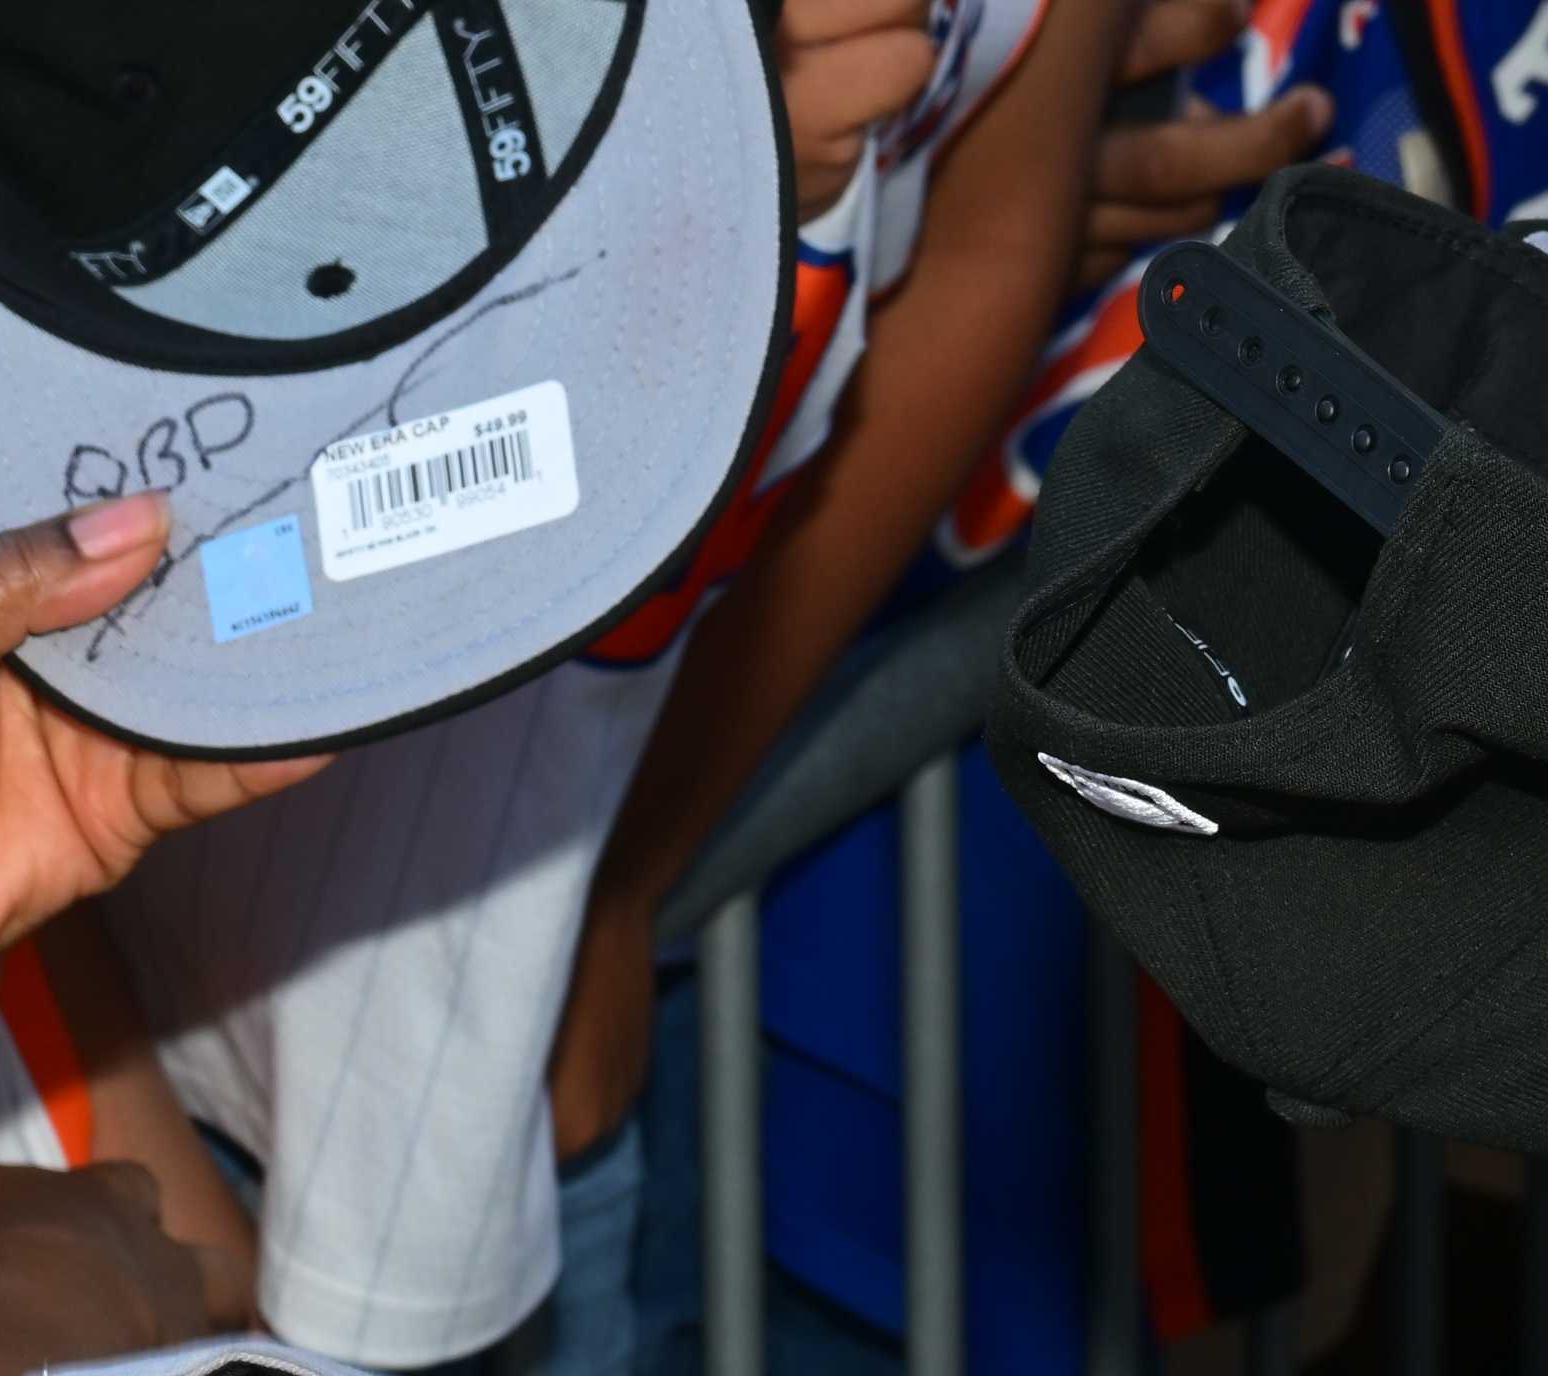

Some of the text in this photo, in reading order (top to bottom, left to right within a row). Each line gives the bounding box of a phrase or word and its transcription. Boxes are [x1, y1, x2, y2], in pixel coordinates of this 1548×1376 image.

[454, 18, 531, 182] 59FIFTY
[323, 438, 367, 464] NEW
[411, 416, 451, 438] CAP
[473, 410, 529, 438] $49.99
